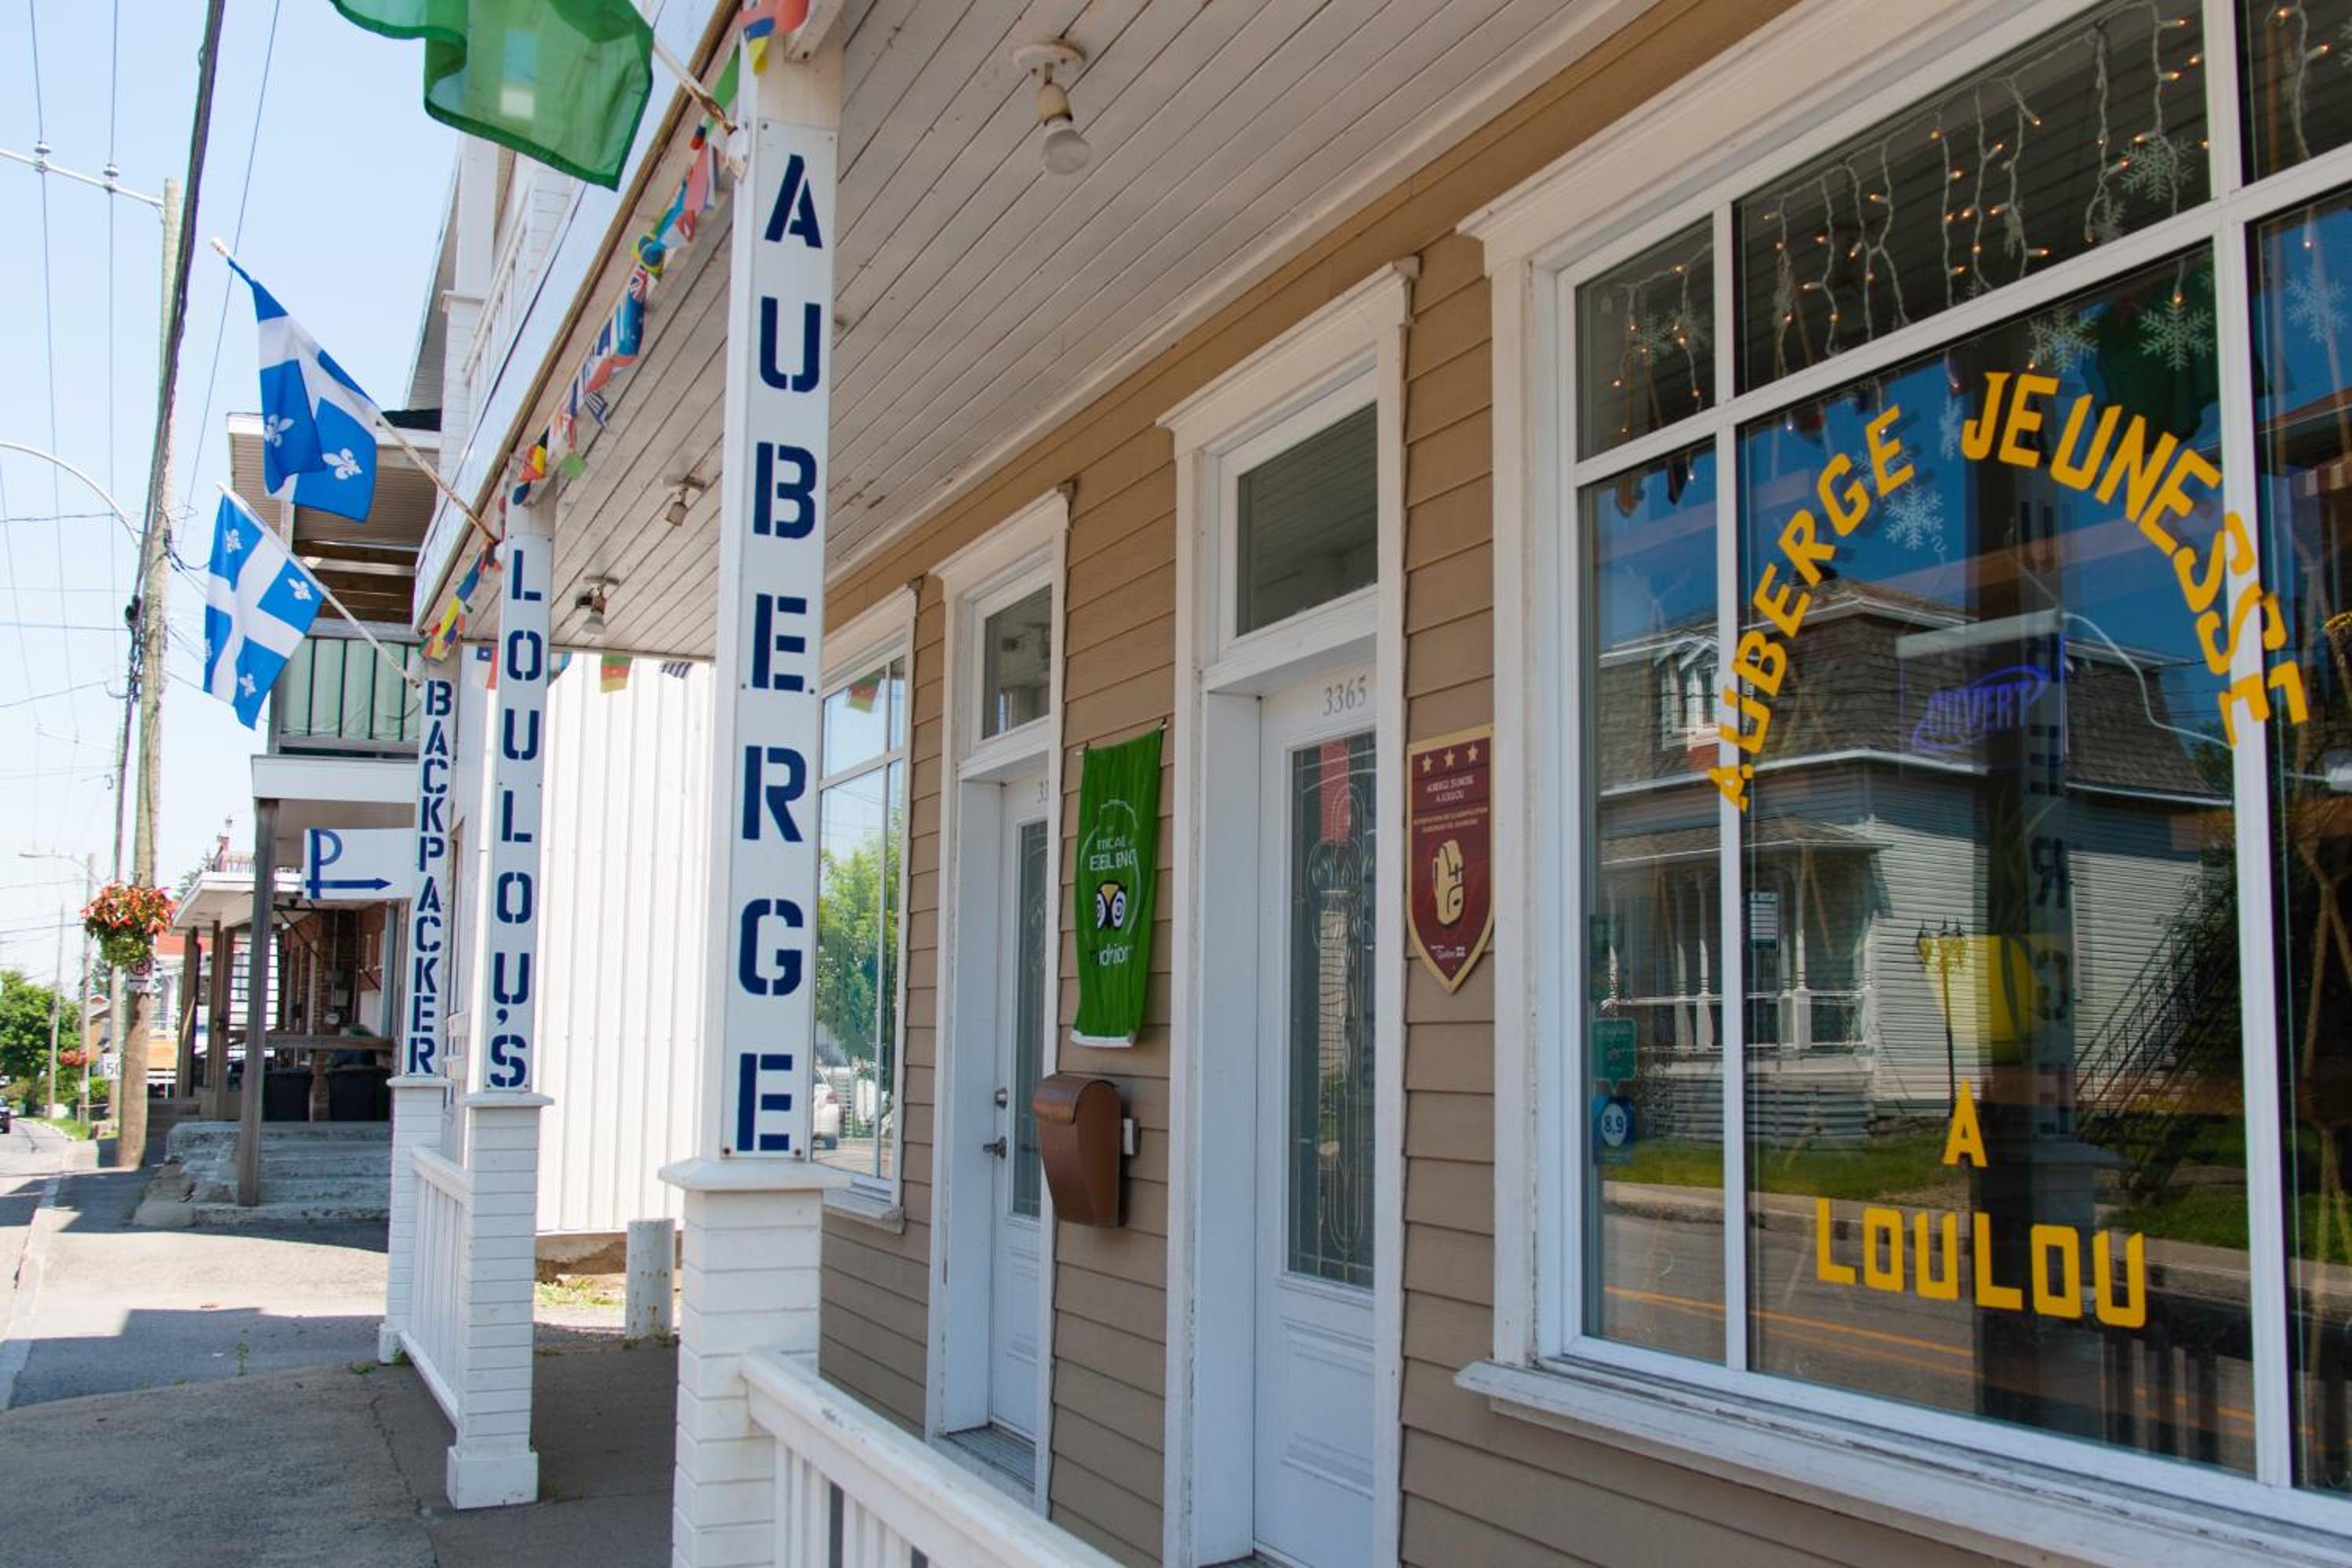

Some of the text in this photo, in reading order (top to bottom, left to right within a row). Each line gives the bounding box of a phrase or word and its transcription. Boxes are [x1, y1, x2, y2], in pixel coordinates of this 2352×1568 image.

[737, 154, 822, 1152] AUBERGE
[1706, 372, 2308, 812] AUBERGE JEUNESSE
[1323, 674, 1367, 716] 3365
[1927, 681, 2032, 739] OUVERT
[310, 829, 343, 899] P
[408, 681, 452, 1074] BACKPACKER
[490, 550, 542, 1087] LOULOU'S
[1943, 1078, 1988, 1168] A
[1815, 1197, 2147, 1329] LOULOU
